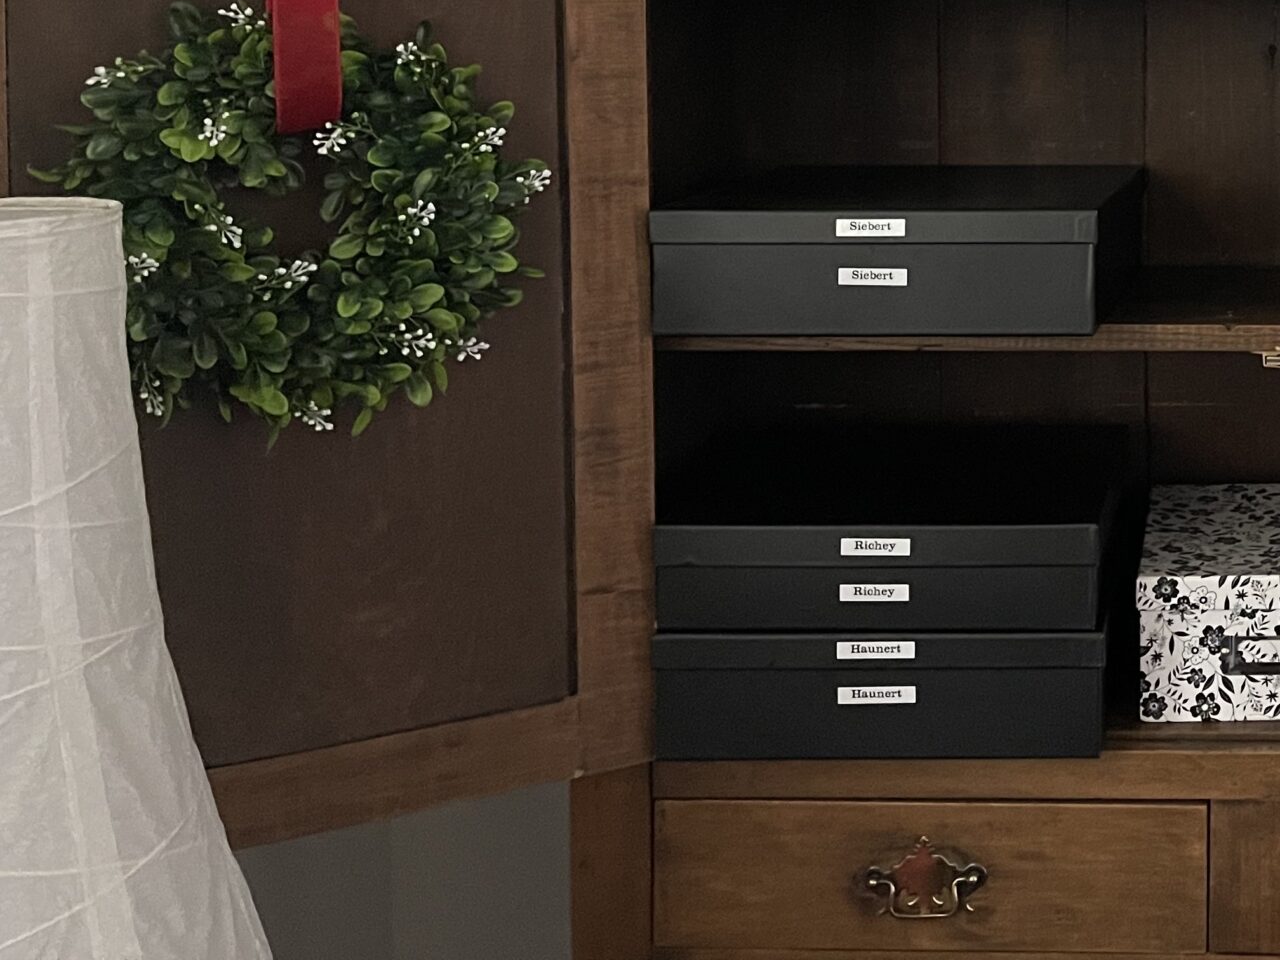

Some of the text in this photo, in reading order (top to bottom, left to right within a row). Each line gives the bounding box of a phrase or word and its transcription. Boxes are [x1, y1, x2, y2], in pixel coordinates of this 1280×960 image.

[849, 221, 891, 231] Siebert
[851, 270, 893, 280] Siebert
[854, 541, 896, 552] Richey
[853, 586, 895, 598] Richey
[850, 644, 901, 654] Haunert
[851, 689, 902, 699] Haunert
